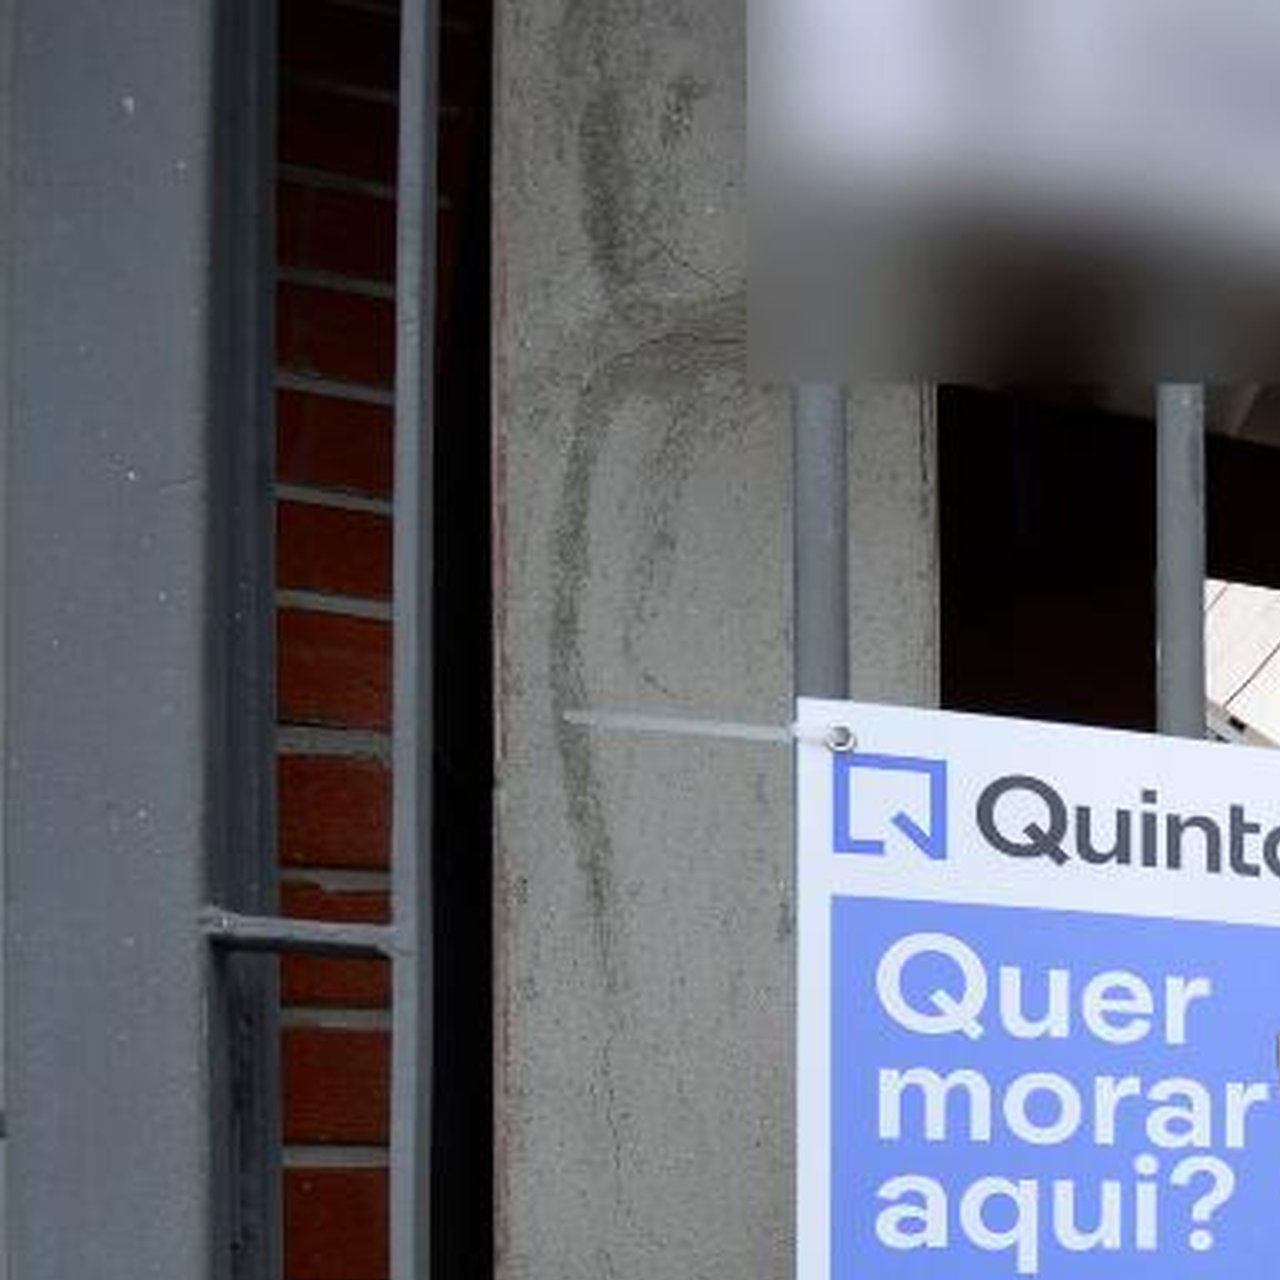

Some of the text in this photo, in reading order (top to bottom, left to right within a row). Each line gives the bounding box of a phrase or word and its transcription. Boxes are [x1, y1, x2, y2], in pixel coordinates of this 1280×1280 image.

[876, 933, 1211, 1045] Quer
[878, 1067, 1268, 1149] morar
[875, 1154, 1236, 1275] aqui?
